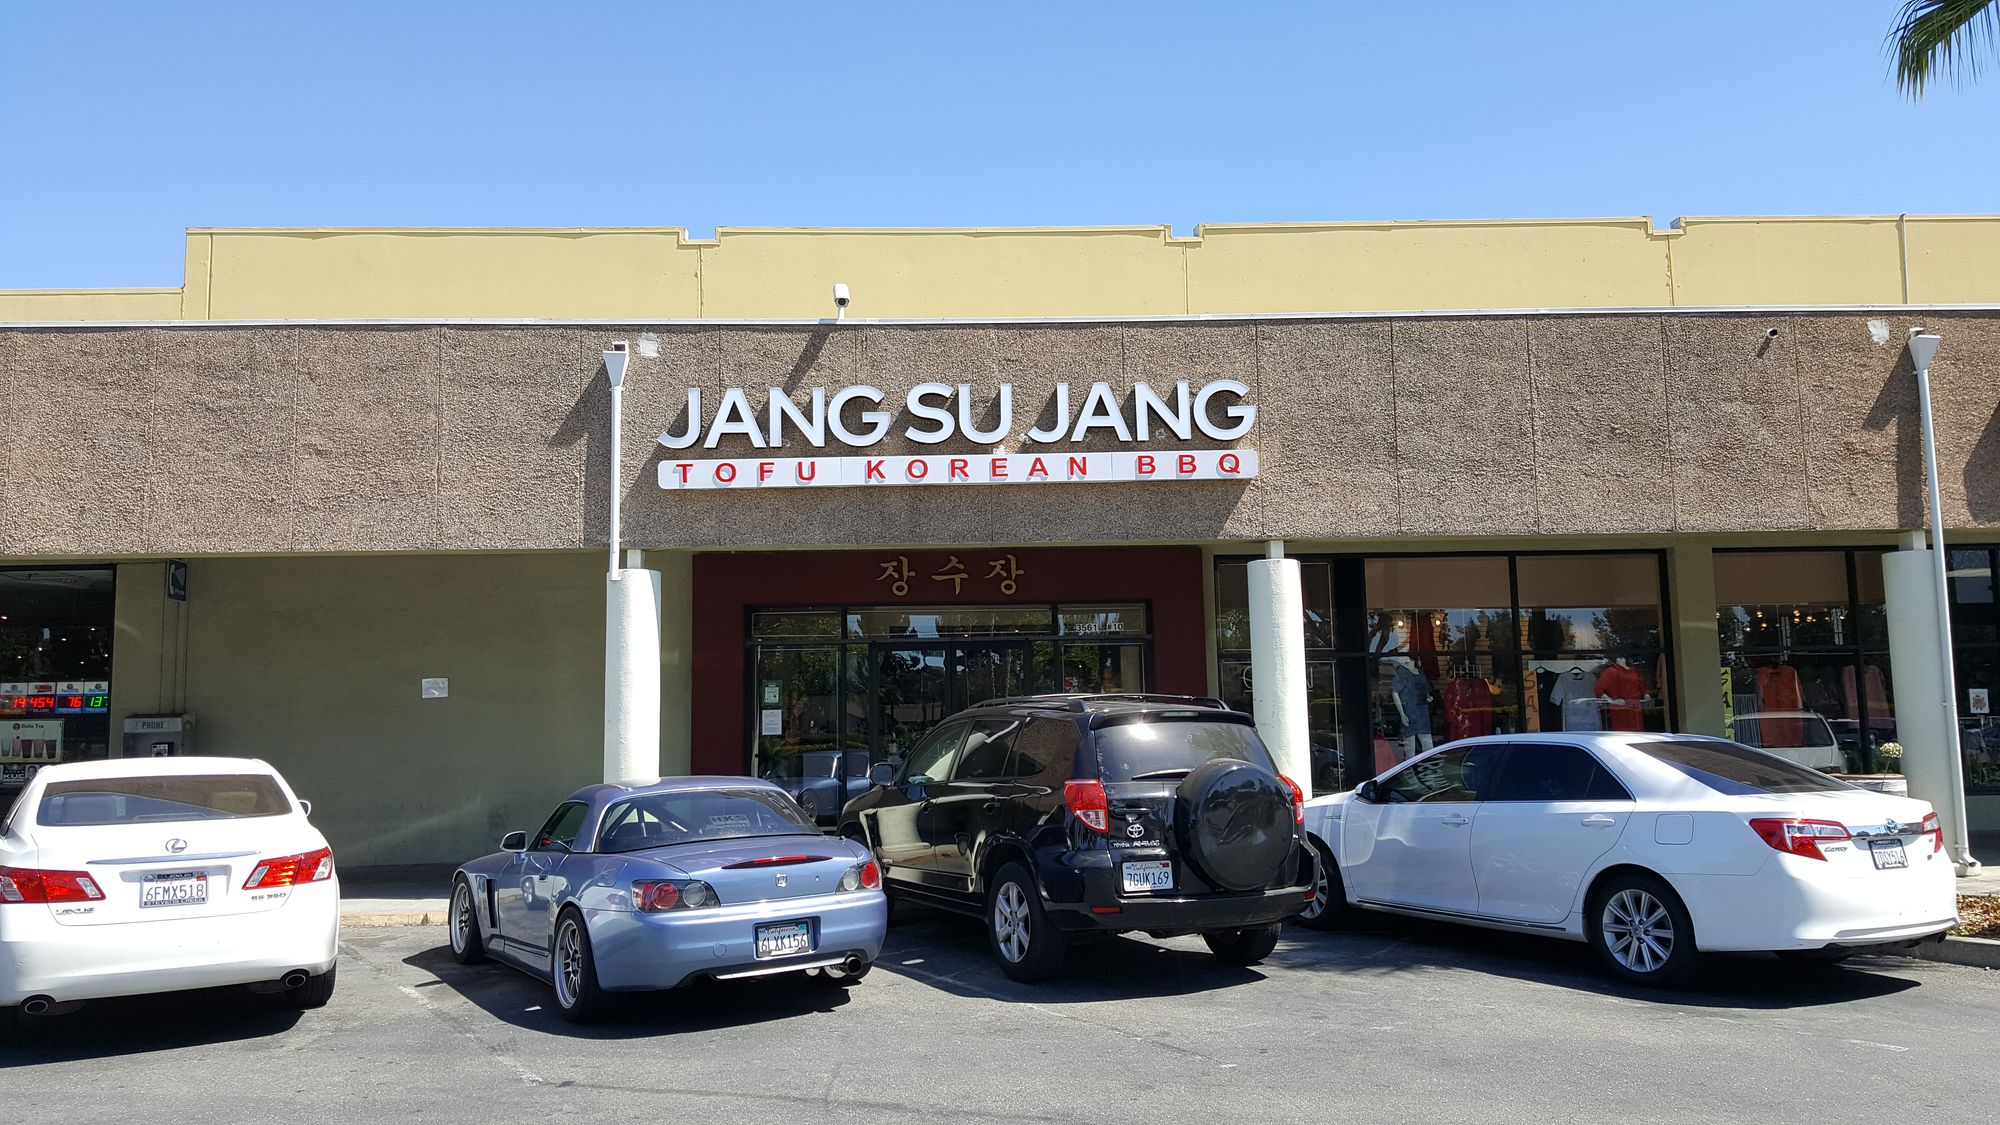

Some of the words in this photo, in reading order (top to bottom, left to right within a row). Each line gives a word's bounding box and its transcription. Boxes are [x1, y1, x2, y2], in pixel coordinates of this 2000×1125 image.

[657, 386, 892, 450] JANG
[904, 383, 1013, 444] SU
[1027, 379, 1257, 444] JANG
[675, 460, 817, 484] TOFU
[866, 456, 1088, 481] KOREAN
[1137, 453, 1241, 475] BBQ
[874, 554, 1025, 597] 장수장
[1075, 623, 1098, 632] 3561
[29, 696, 55, 708] 454
[67, 696, 82, 708] 76
[142, 721, 165, 729] PHONE
[1126, 871, 1170, 887] 7GUK169
[145, 883, 205, 902] 6FMX518
[760, 932, 807, 951] 6LXK156
